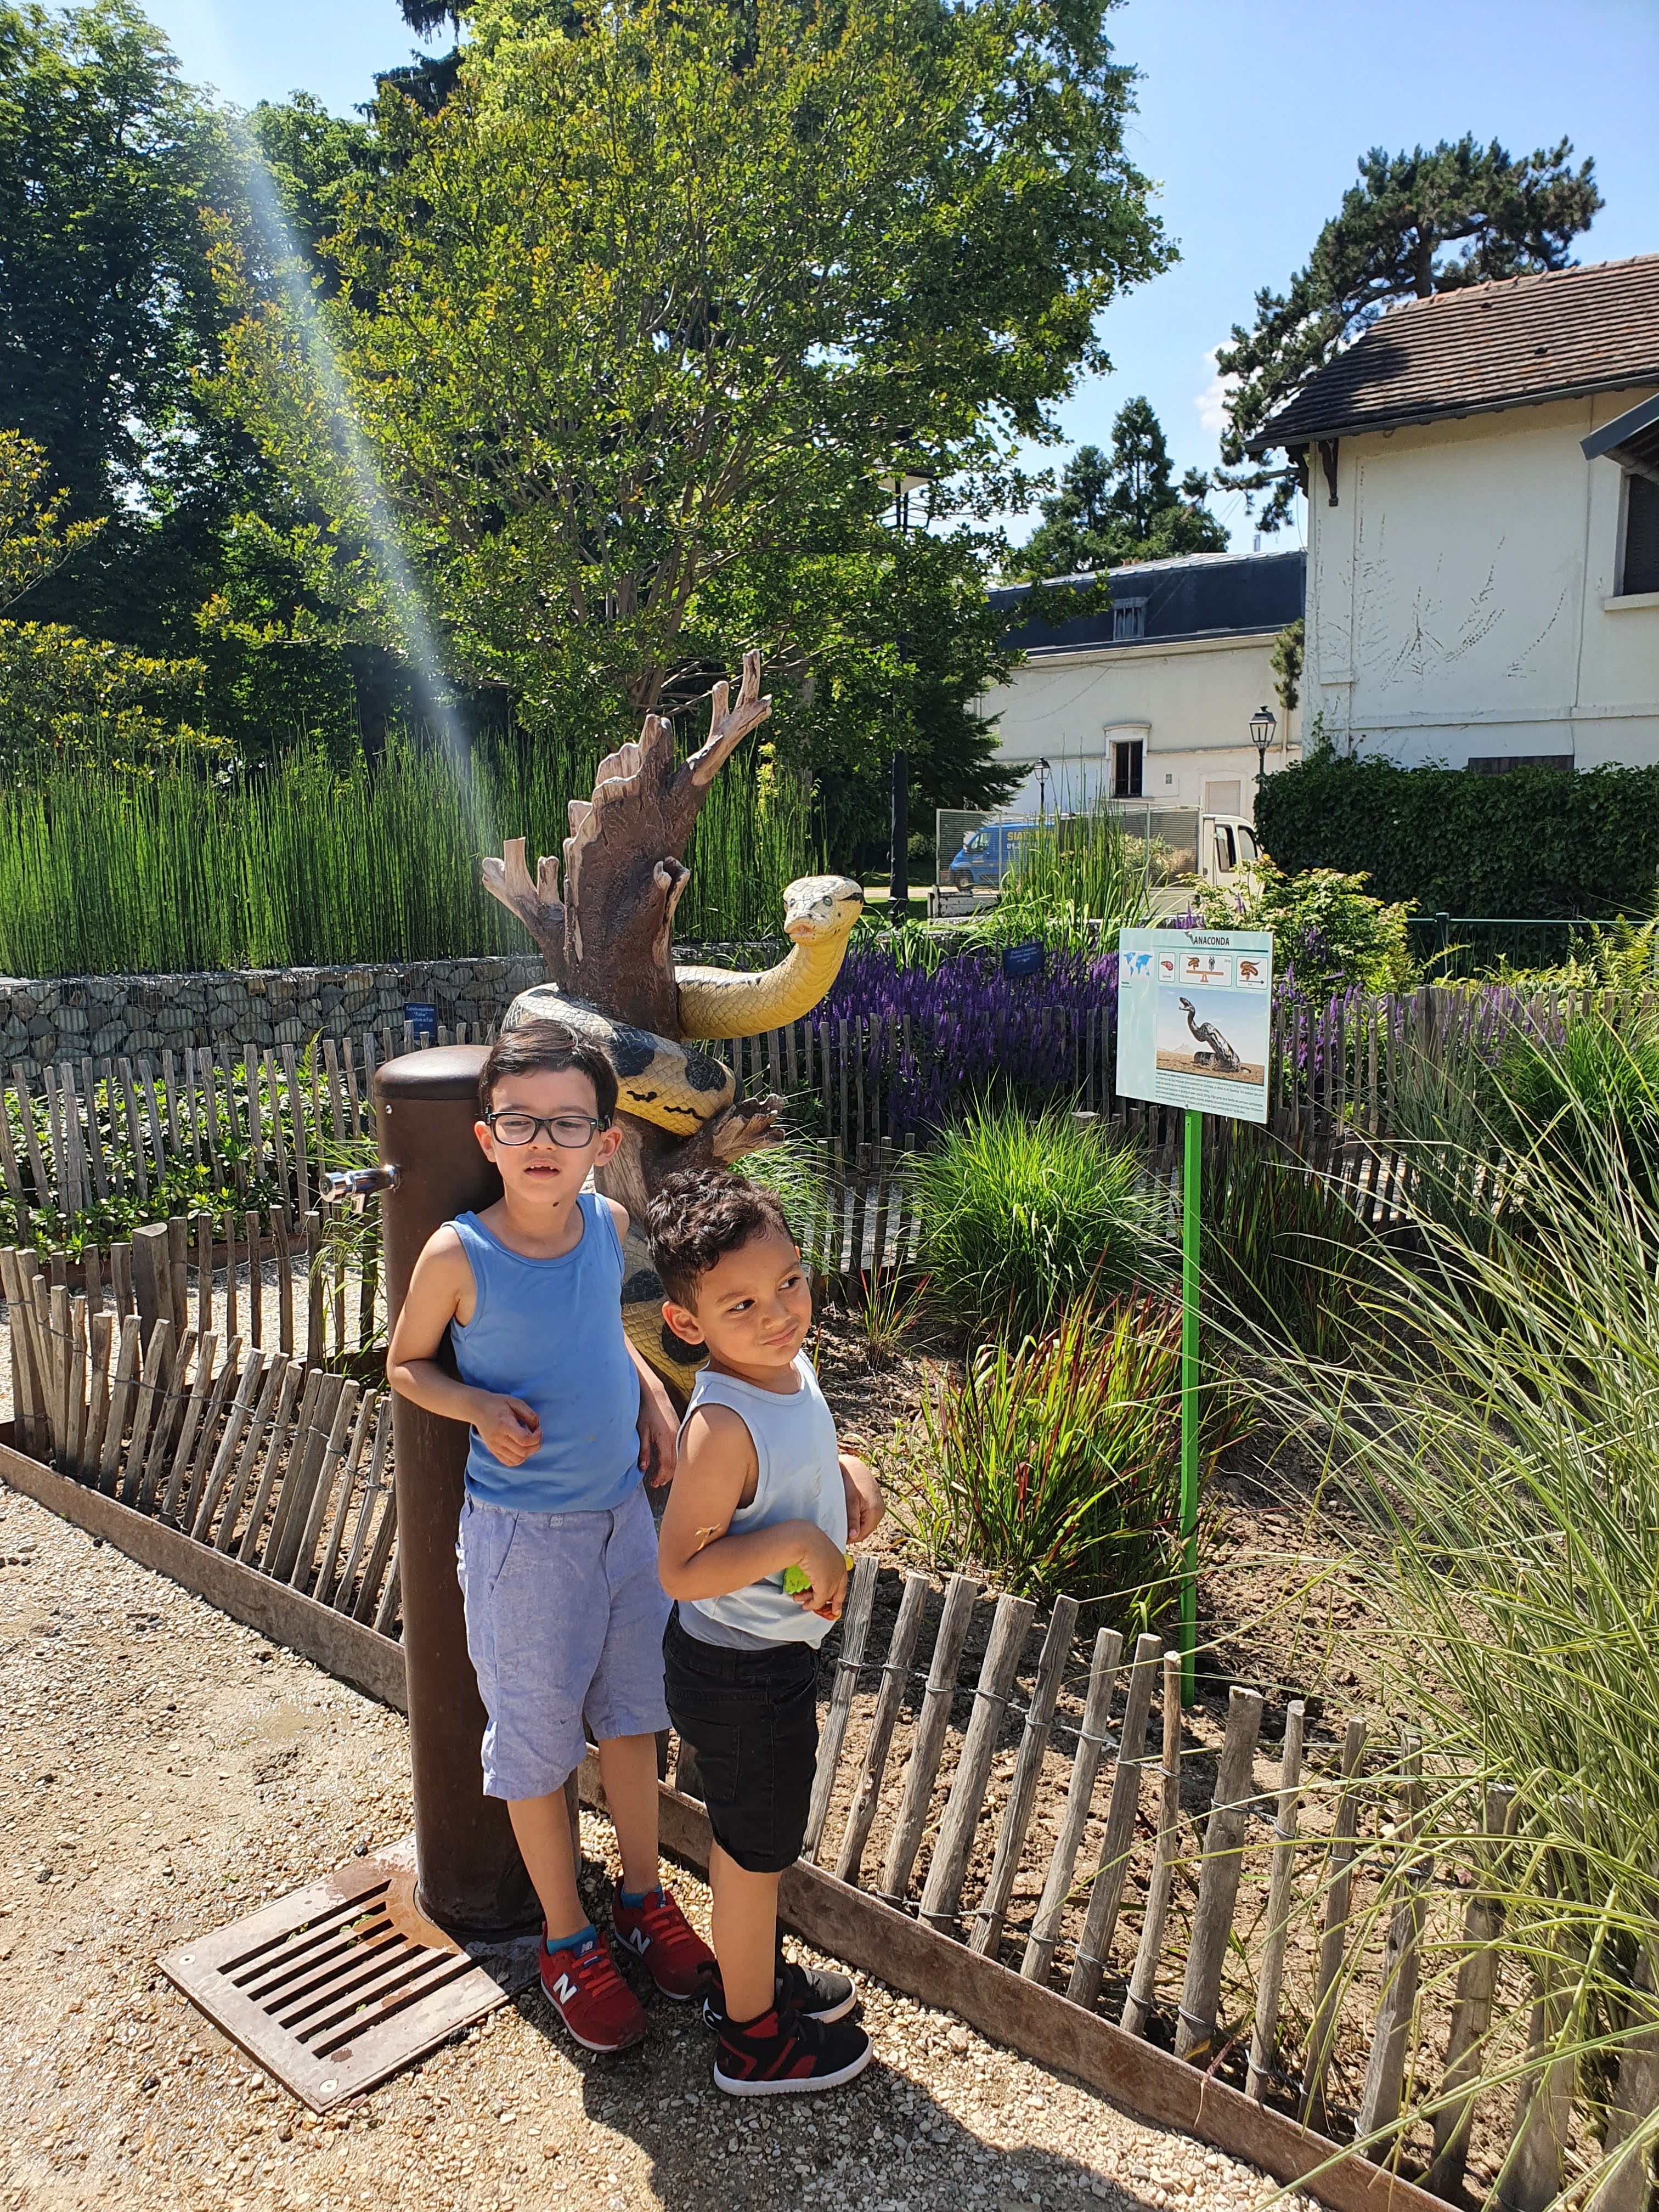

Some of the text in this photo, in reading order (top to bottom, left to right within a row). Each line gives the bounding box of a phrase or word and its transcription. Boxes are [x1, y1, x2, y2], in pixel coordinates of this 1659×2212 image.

[1194, 936, 1229, 946] ANACONDA
[630, 1927, 652, 1955] N
[552, 1973, 577, 2005] N
